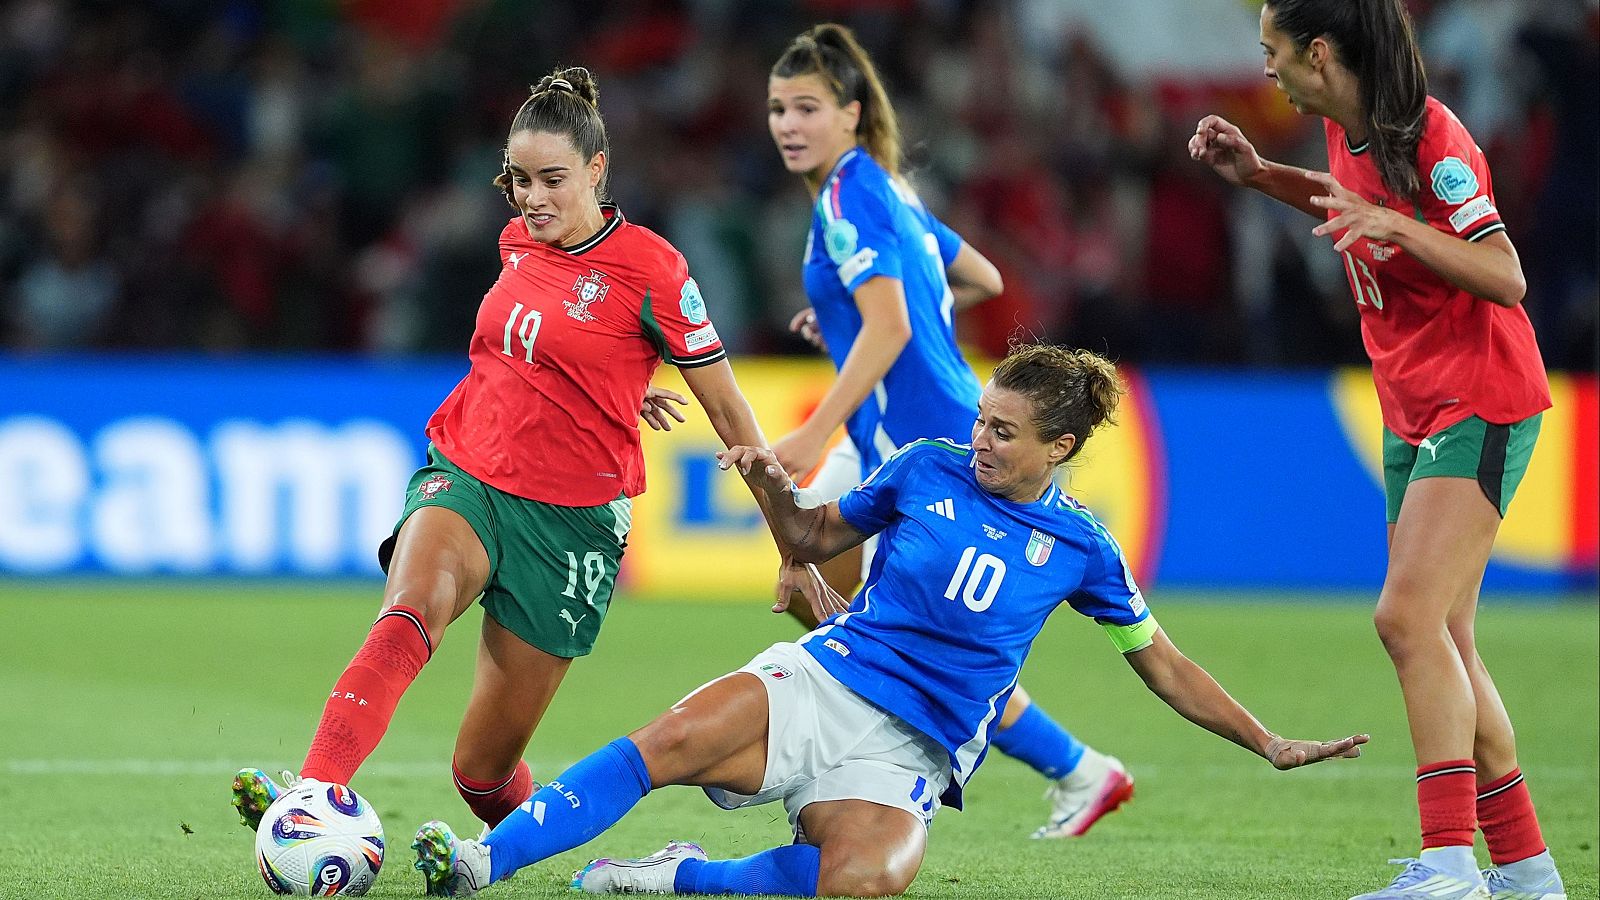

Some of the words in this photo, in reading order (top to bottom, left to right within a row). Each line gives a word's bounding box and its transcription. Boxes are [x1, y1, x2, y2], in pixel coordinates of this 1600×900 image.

[1344, 250, 1384, 310] 13
[501, 302, 543, 365] 19
[1033, 530, 1053, 545] ITALIA
[560, 550, 606, 605] 19
[943, 546, 1007, 612] 10
